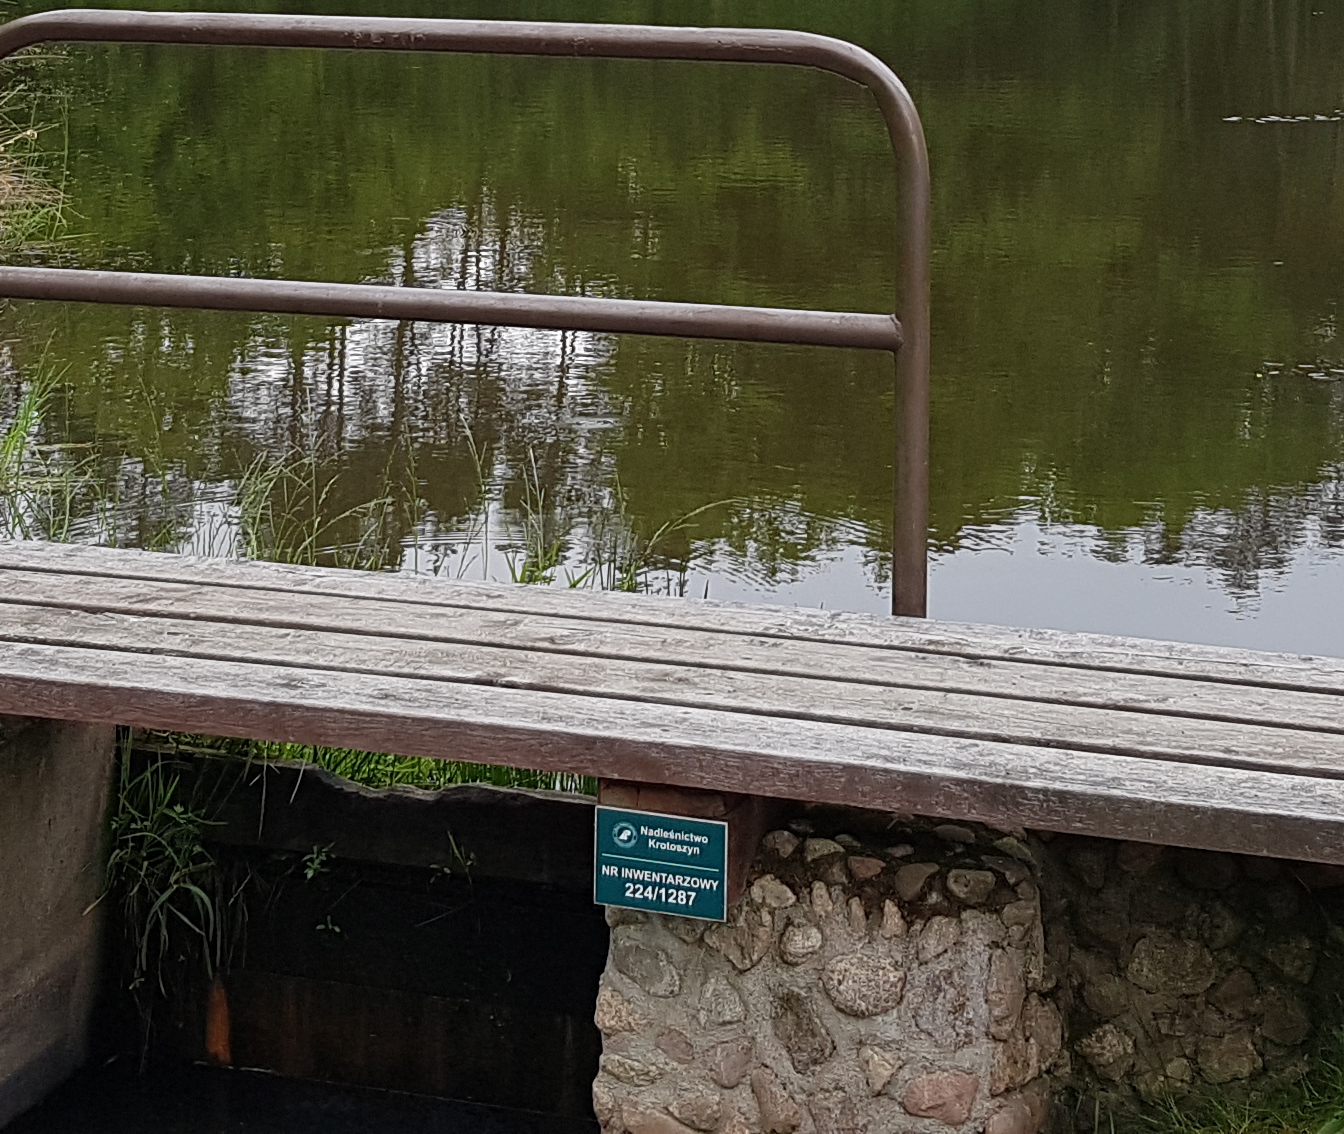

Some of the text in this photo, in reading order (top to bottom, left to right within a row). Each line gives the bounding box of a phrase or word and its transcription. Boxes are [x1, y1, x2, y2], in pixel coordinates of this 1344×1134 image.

[640, 825, 709, 844] Nadleśnictwo
[648, 838, 700, 856] Krotoszyn
[601, 864, 719, 891] NR INWENTARZOWY
[624, 882, 697, 906] 224/1287
